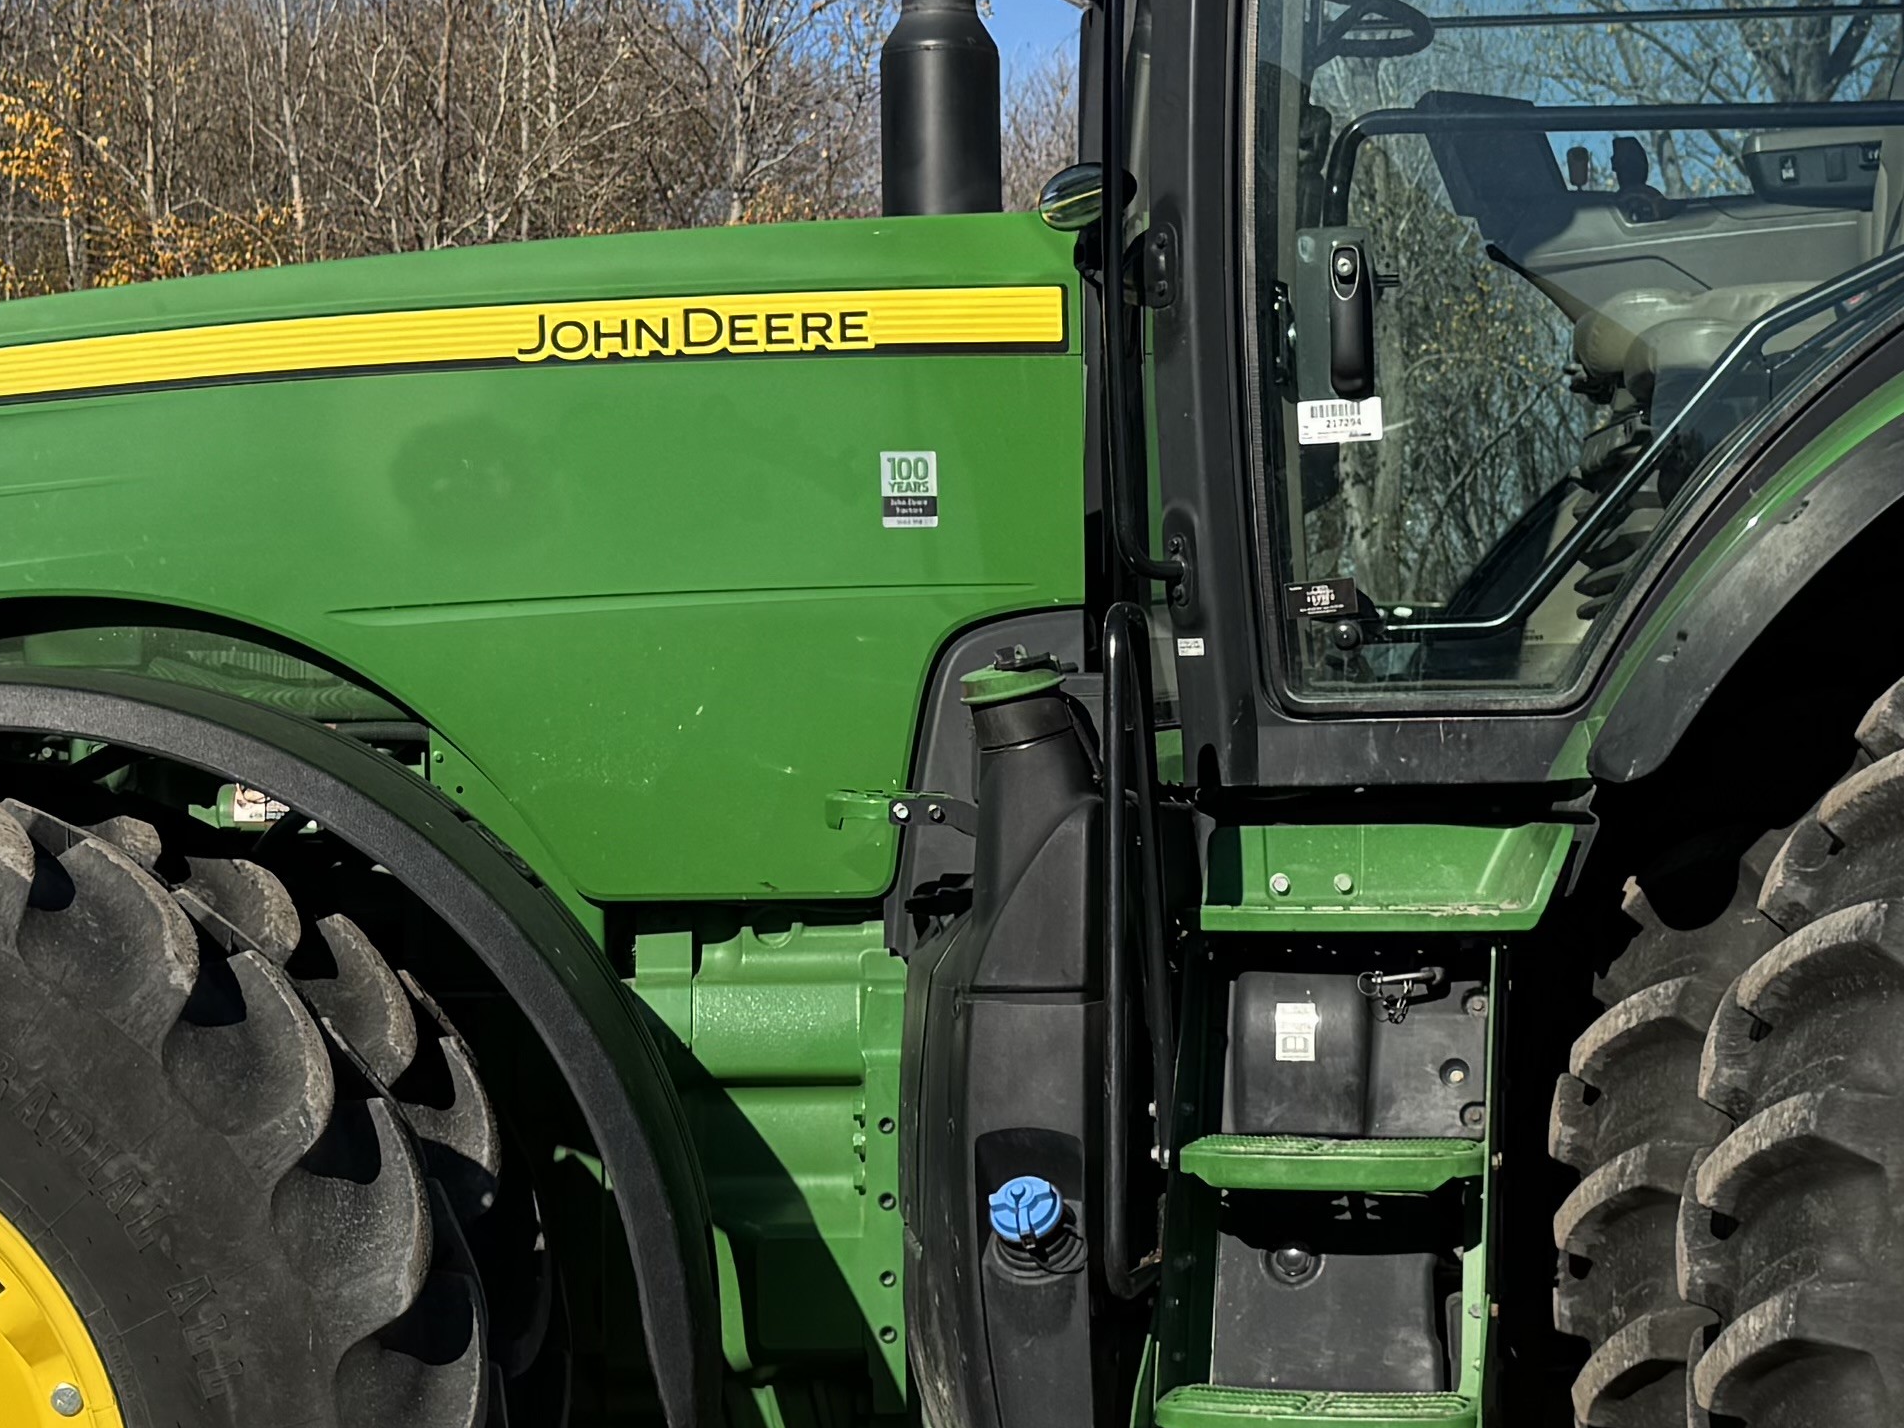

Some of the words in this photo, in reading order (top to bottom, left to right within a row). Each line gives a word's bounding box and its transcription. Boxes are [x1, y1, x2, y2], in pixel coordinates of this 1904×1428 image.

[519, 314, 670, 355] JOHN
[683, 309, 868, 347] DEERE
[887, 457, 929, 481] 100
[888, 481, 929, 493] YEARS
[166, 1275, 244, 1400] ALL
